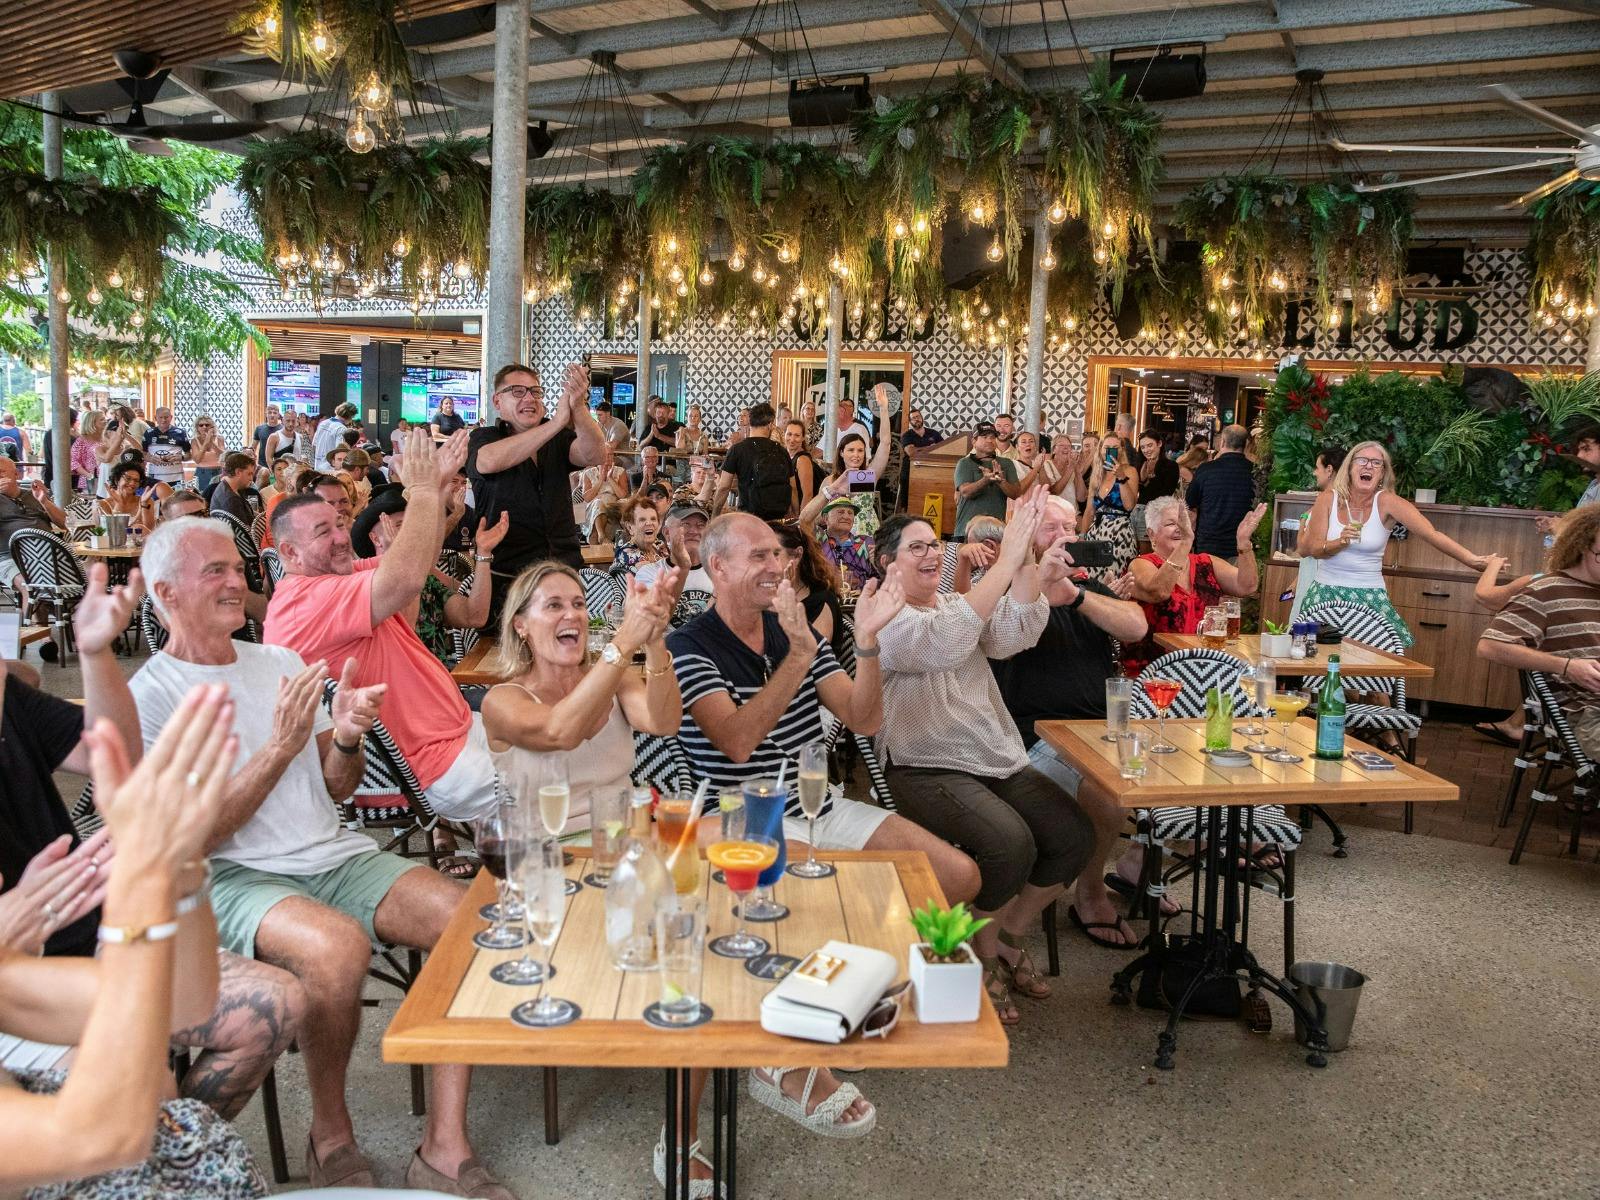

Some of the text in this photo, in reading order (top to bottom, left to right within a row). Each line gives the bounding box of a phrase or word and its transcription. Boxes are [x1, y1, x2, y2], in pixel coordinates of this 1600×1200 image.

[810, 391, 826, 406] TA
[1392, 525, 1407, 537] 22
[689, 591, 709, 601] BRE
